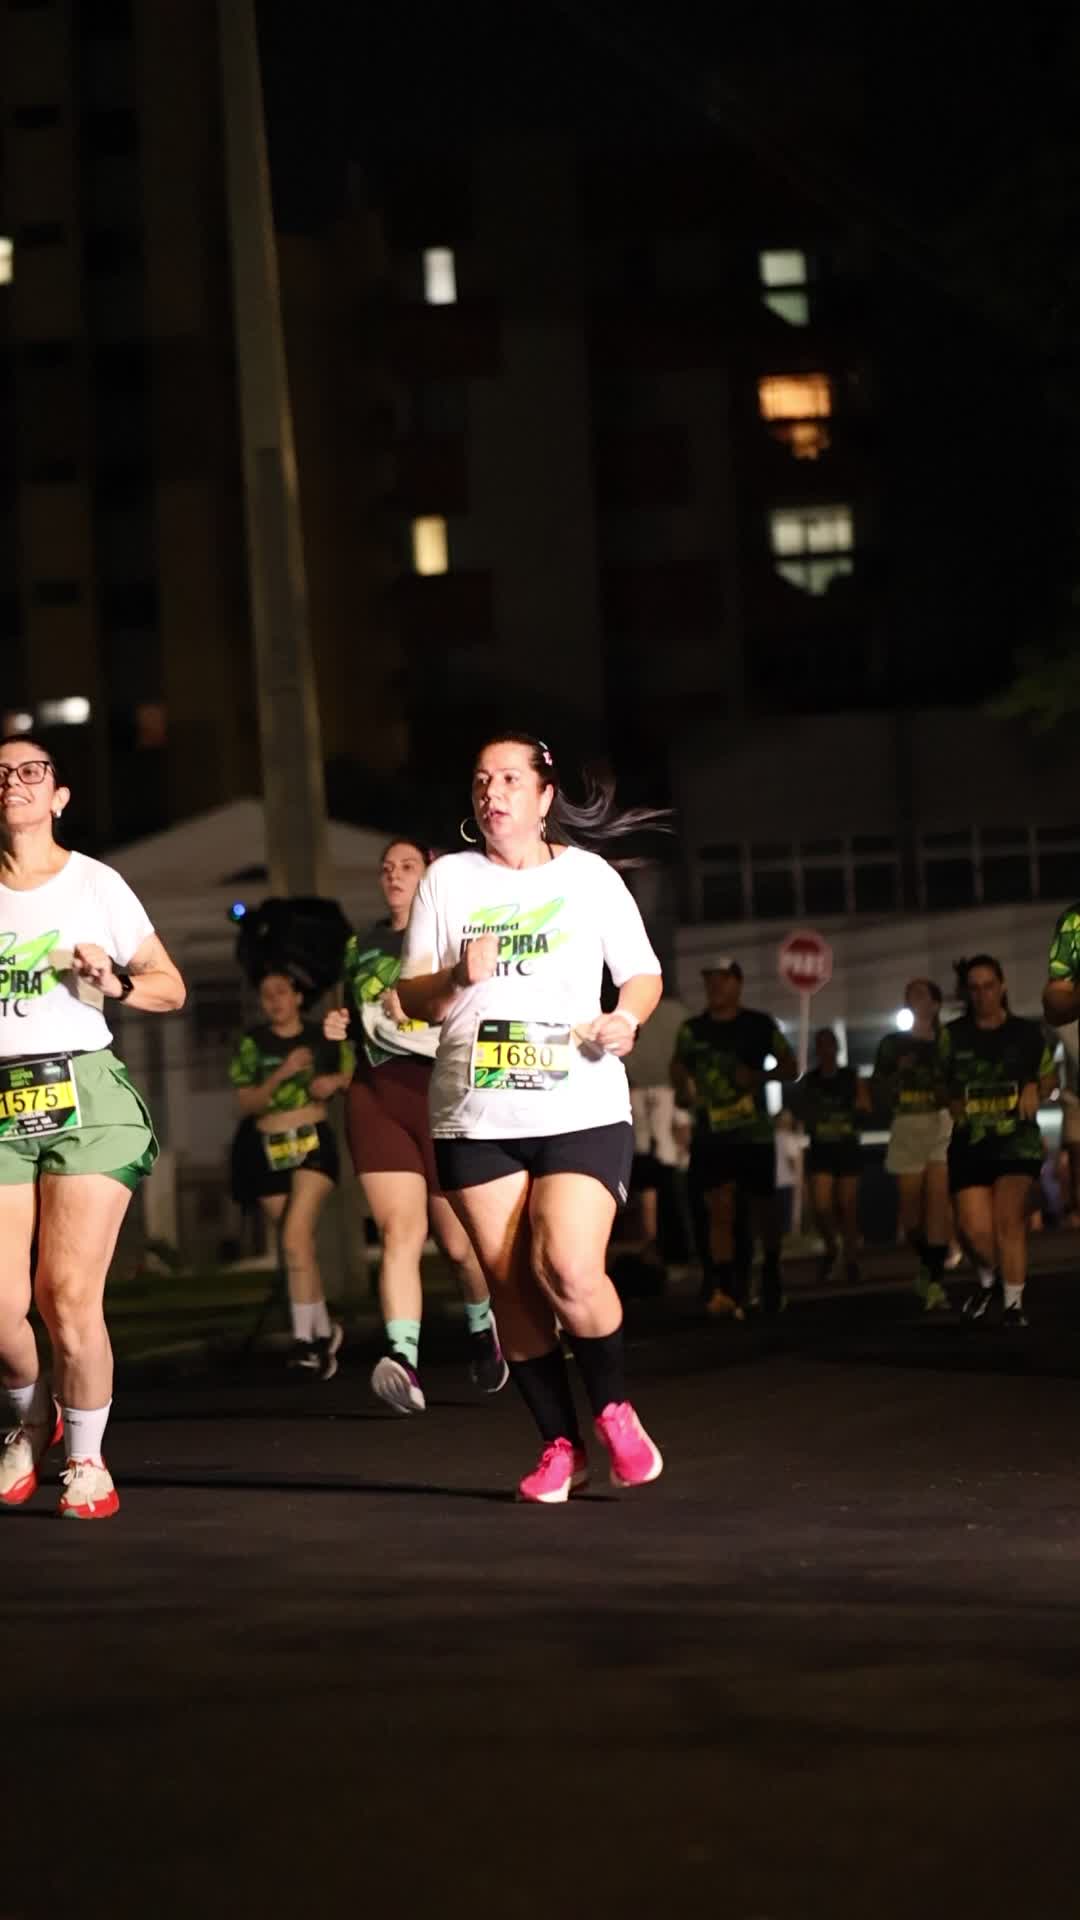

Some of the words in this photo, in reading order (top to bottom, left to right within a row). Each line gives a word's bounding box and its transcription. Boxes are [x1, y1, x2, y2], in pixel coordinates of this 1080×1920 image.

[462, 922, 519, 934] Unimed
[460, 933, 549, 958] IPIRA
[493, 1044, 553, 1067] 1680
[0, 1087, 58, 1115] 1575
